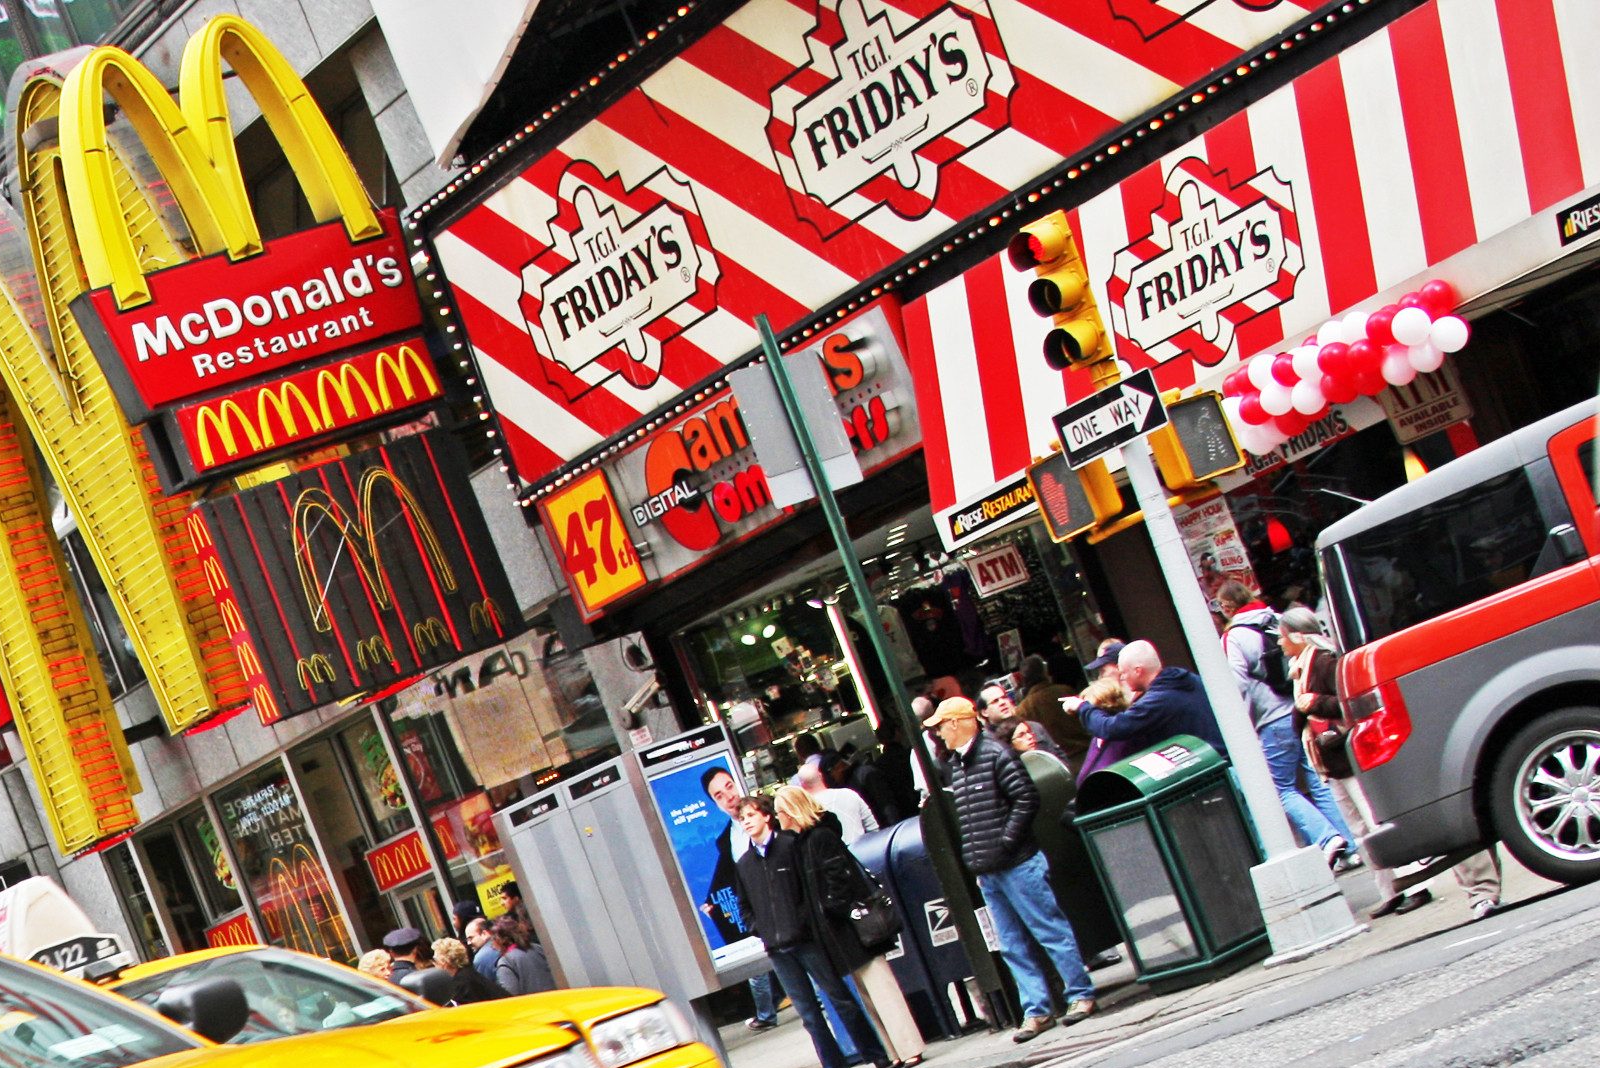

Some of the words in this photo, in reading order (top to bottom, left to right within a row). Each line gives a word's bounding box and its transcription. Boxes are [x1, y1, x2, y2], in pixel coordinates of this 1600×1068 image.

[847, 35, 892, 80] T.G.I.
[804, 29, 969, 171] FRIDAY'S
[582, 227, 621, 262] T.G.I.
[1181, 215, 1214, 253] T.G.I.
[549, 224, 683, 341] FRIDAY'S
[1137, 219, 1272, 322] FRIDAY'S
[131, 252, 405, 362] McDonald's
[191, 305, 375, 379] Restaurant
[1071, 415, 1102, 445] ONE
[1109, 394, 1143, 427] WAY
[1399, 395, 1460, 428] AVAILABLE
[1415, 412, 1452, 433] INSIDE
[631, 480, 698, 528] DIGITAL
[981, 482, 1035, 519] RESTAURA
[976, 551, 1022, 587] ATM
[711, 886, 734, 905] LATE
